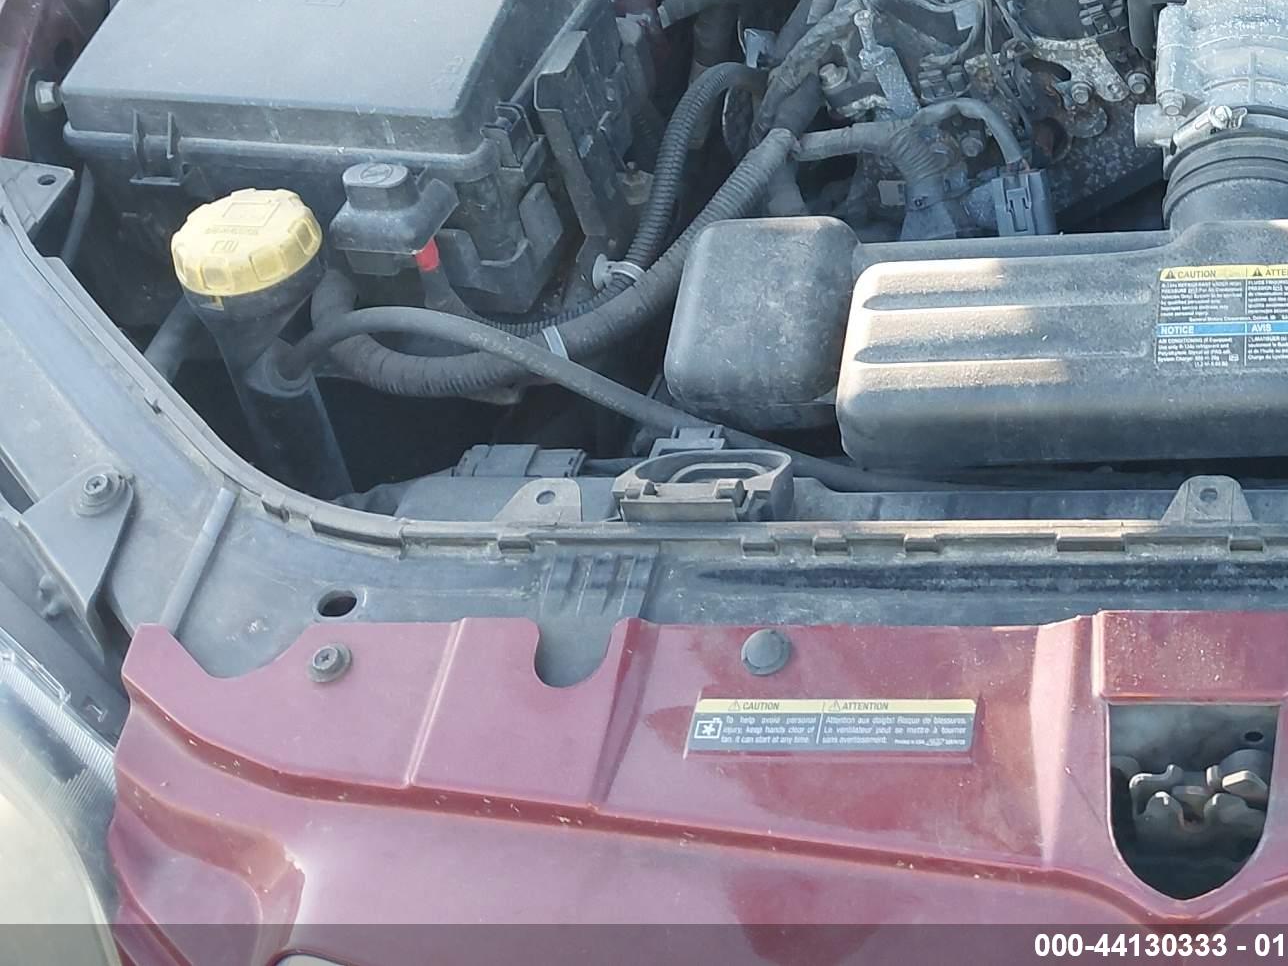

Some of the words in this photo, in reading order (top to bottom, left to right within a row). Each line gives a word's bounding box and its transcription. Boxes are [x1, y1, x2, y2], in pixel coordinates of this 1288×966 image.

[1177, 270, 1216, 278] CAUTION
[1160, 325, 1195, 334] NOTICE
[1251, 324, 1272, 332] AVIS
[743, 702, 780, 711] CAUTION
[842, 702, 889, 711] ATTENTION
